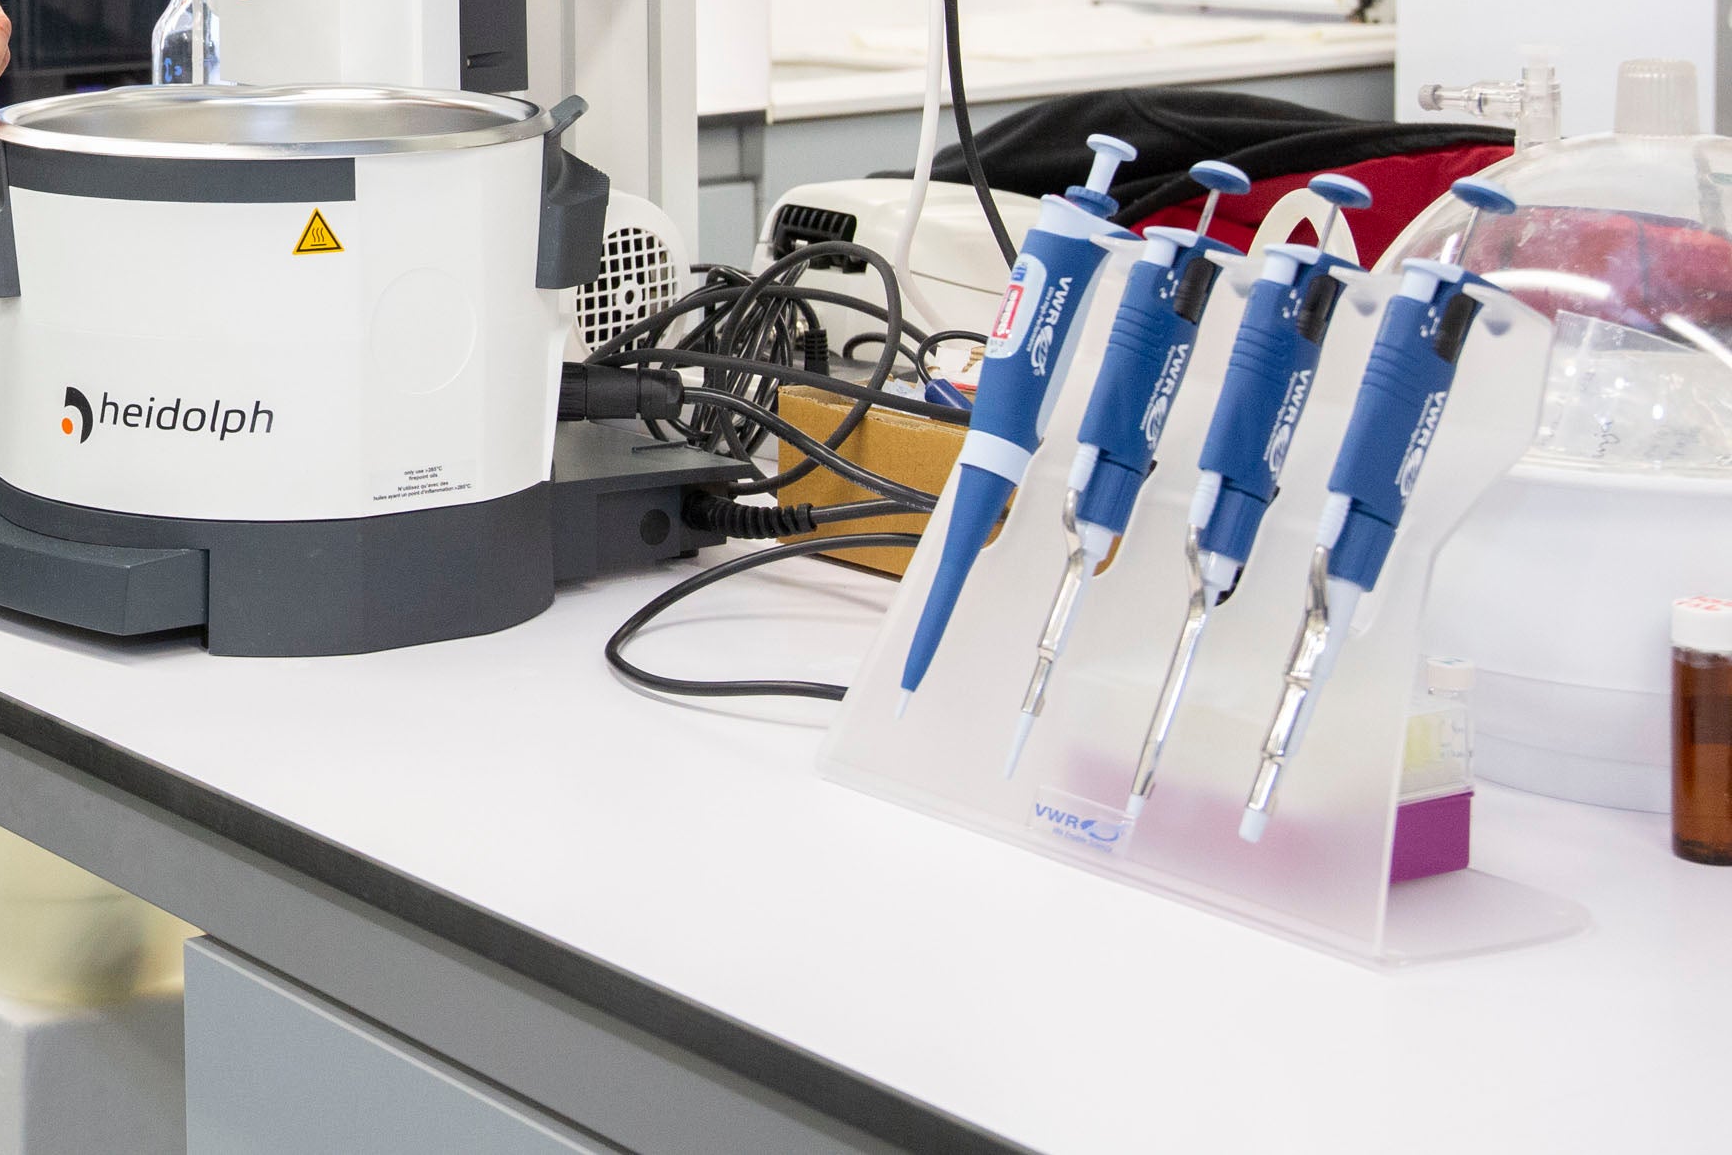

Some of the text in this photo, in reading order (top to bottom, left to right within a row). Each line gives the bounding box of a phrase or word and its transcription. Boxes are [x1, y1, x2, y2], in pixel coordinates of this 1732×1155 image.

[1045, 277, 1073, 326] VWR
[1161, 343, 1189, 395] VWR
[99, 391, 274, 441] heidolph
[1284, 369, 1312, 423] VWR
[1417, 391, 1448, 446] VWR
[1035, 803, 1079, 830] VWR
